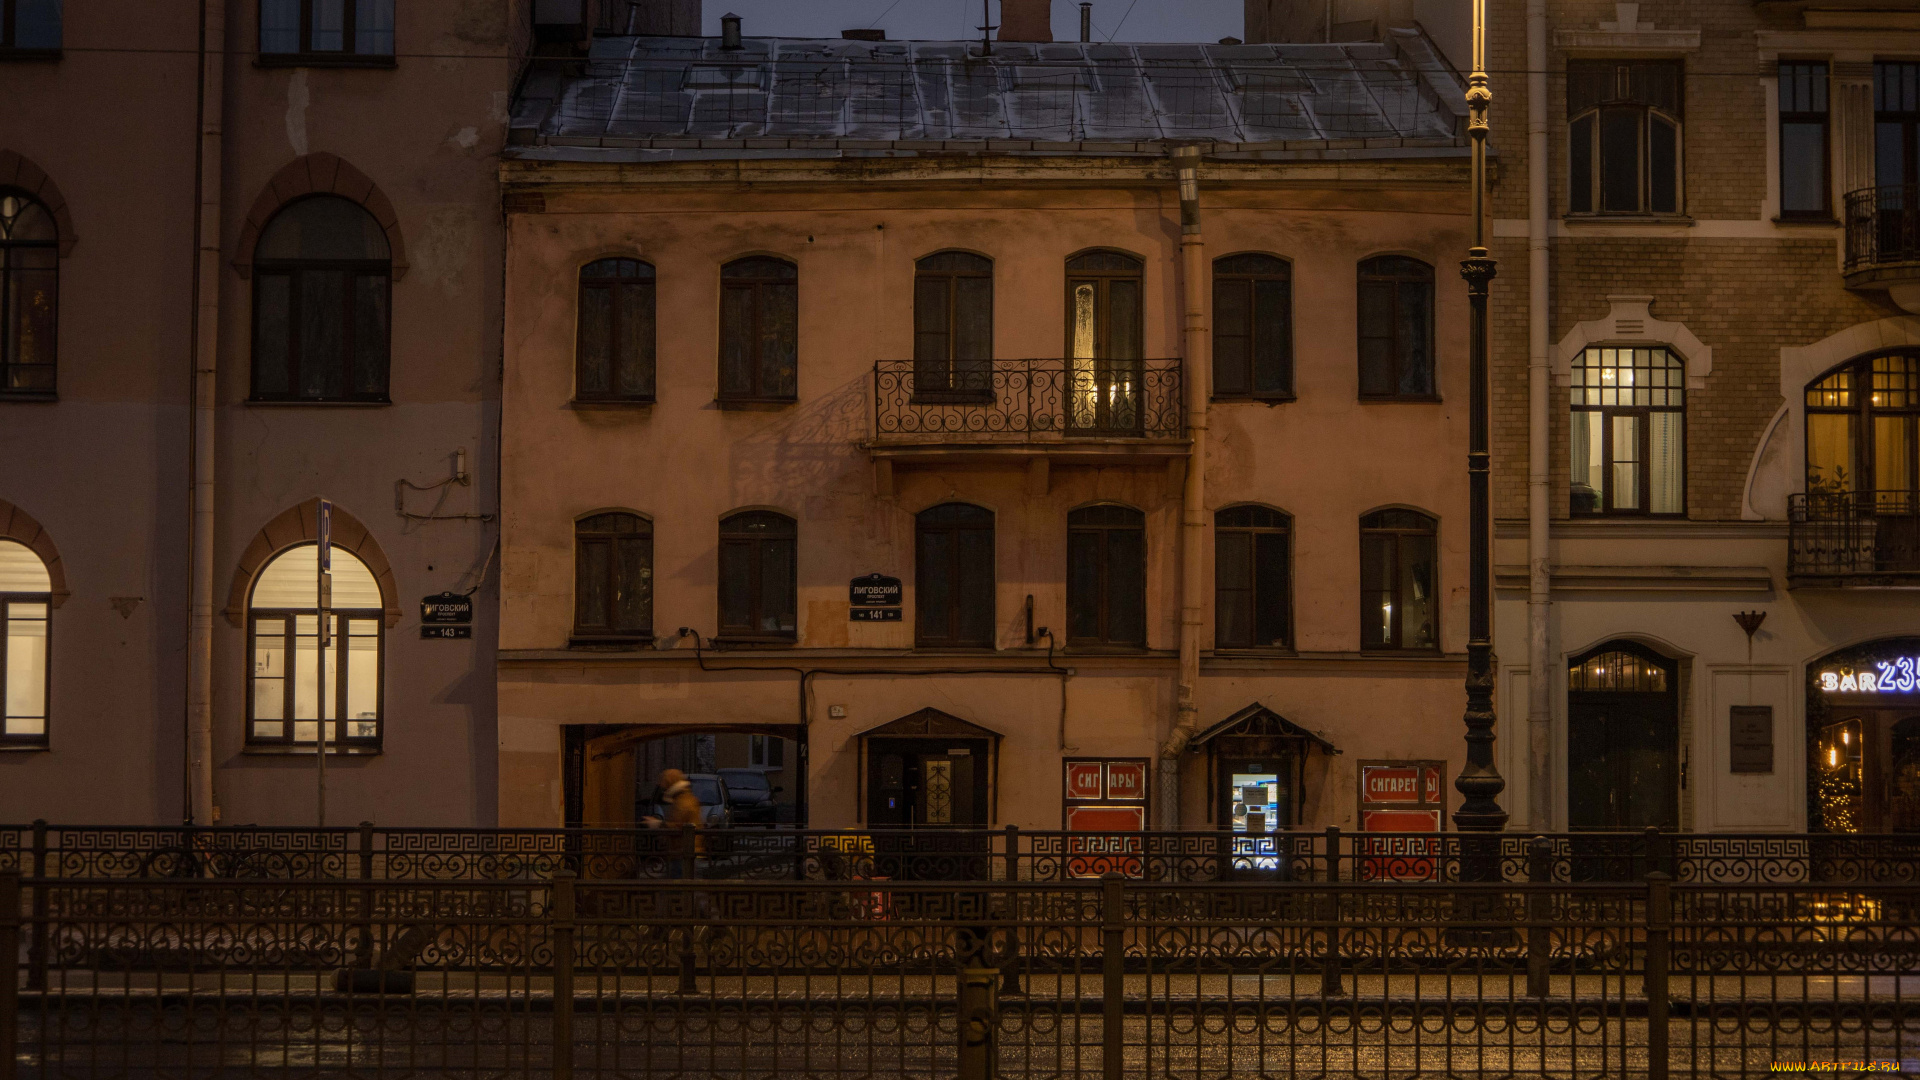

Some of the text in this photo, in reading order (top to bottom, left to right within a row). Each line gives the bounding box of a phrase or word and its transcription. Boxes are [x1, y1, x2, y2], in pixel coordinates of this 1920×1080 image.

[853, 585, 898, 594] ЛИГОВСКИЙ
[424, 603, 469, 612] ЛИГОВСКИЙ
[869, 610, 883, 620] 141
[441, 628, 455, 637] 143
[1821, 672, 1876, 691] BAR
